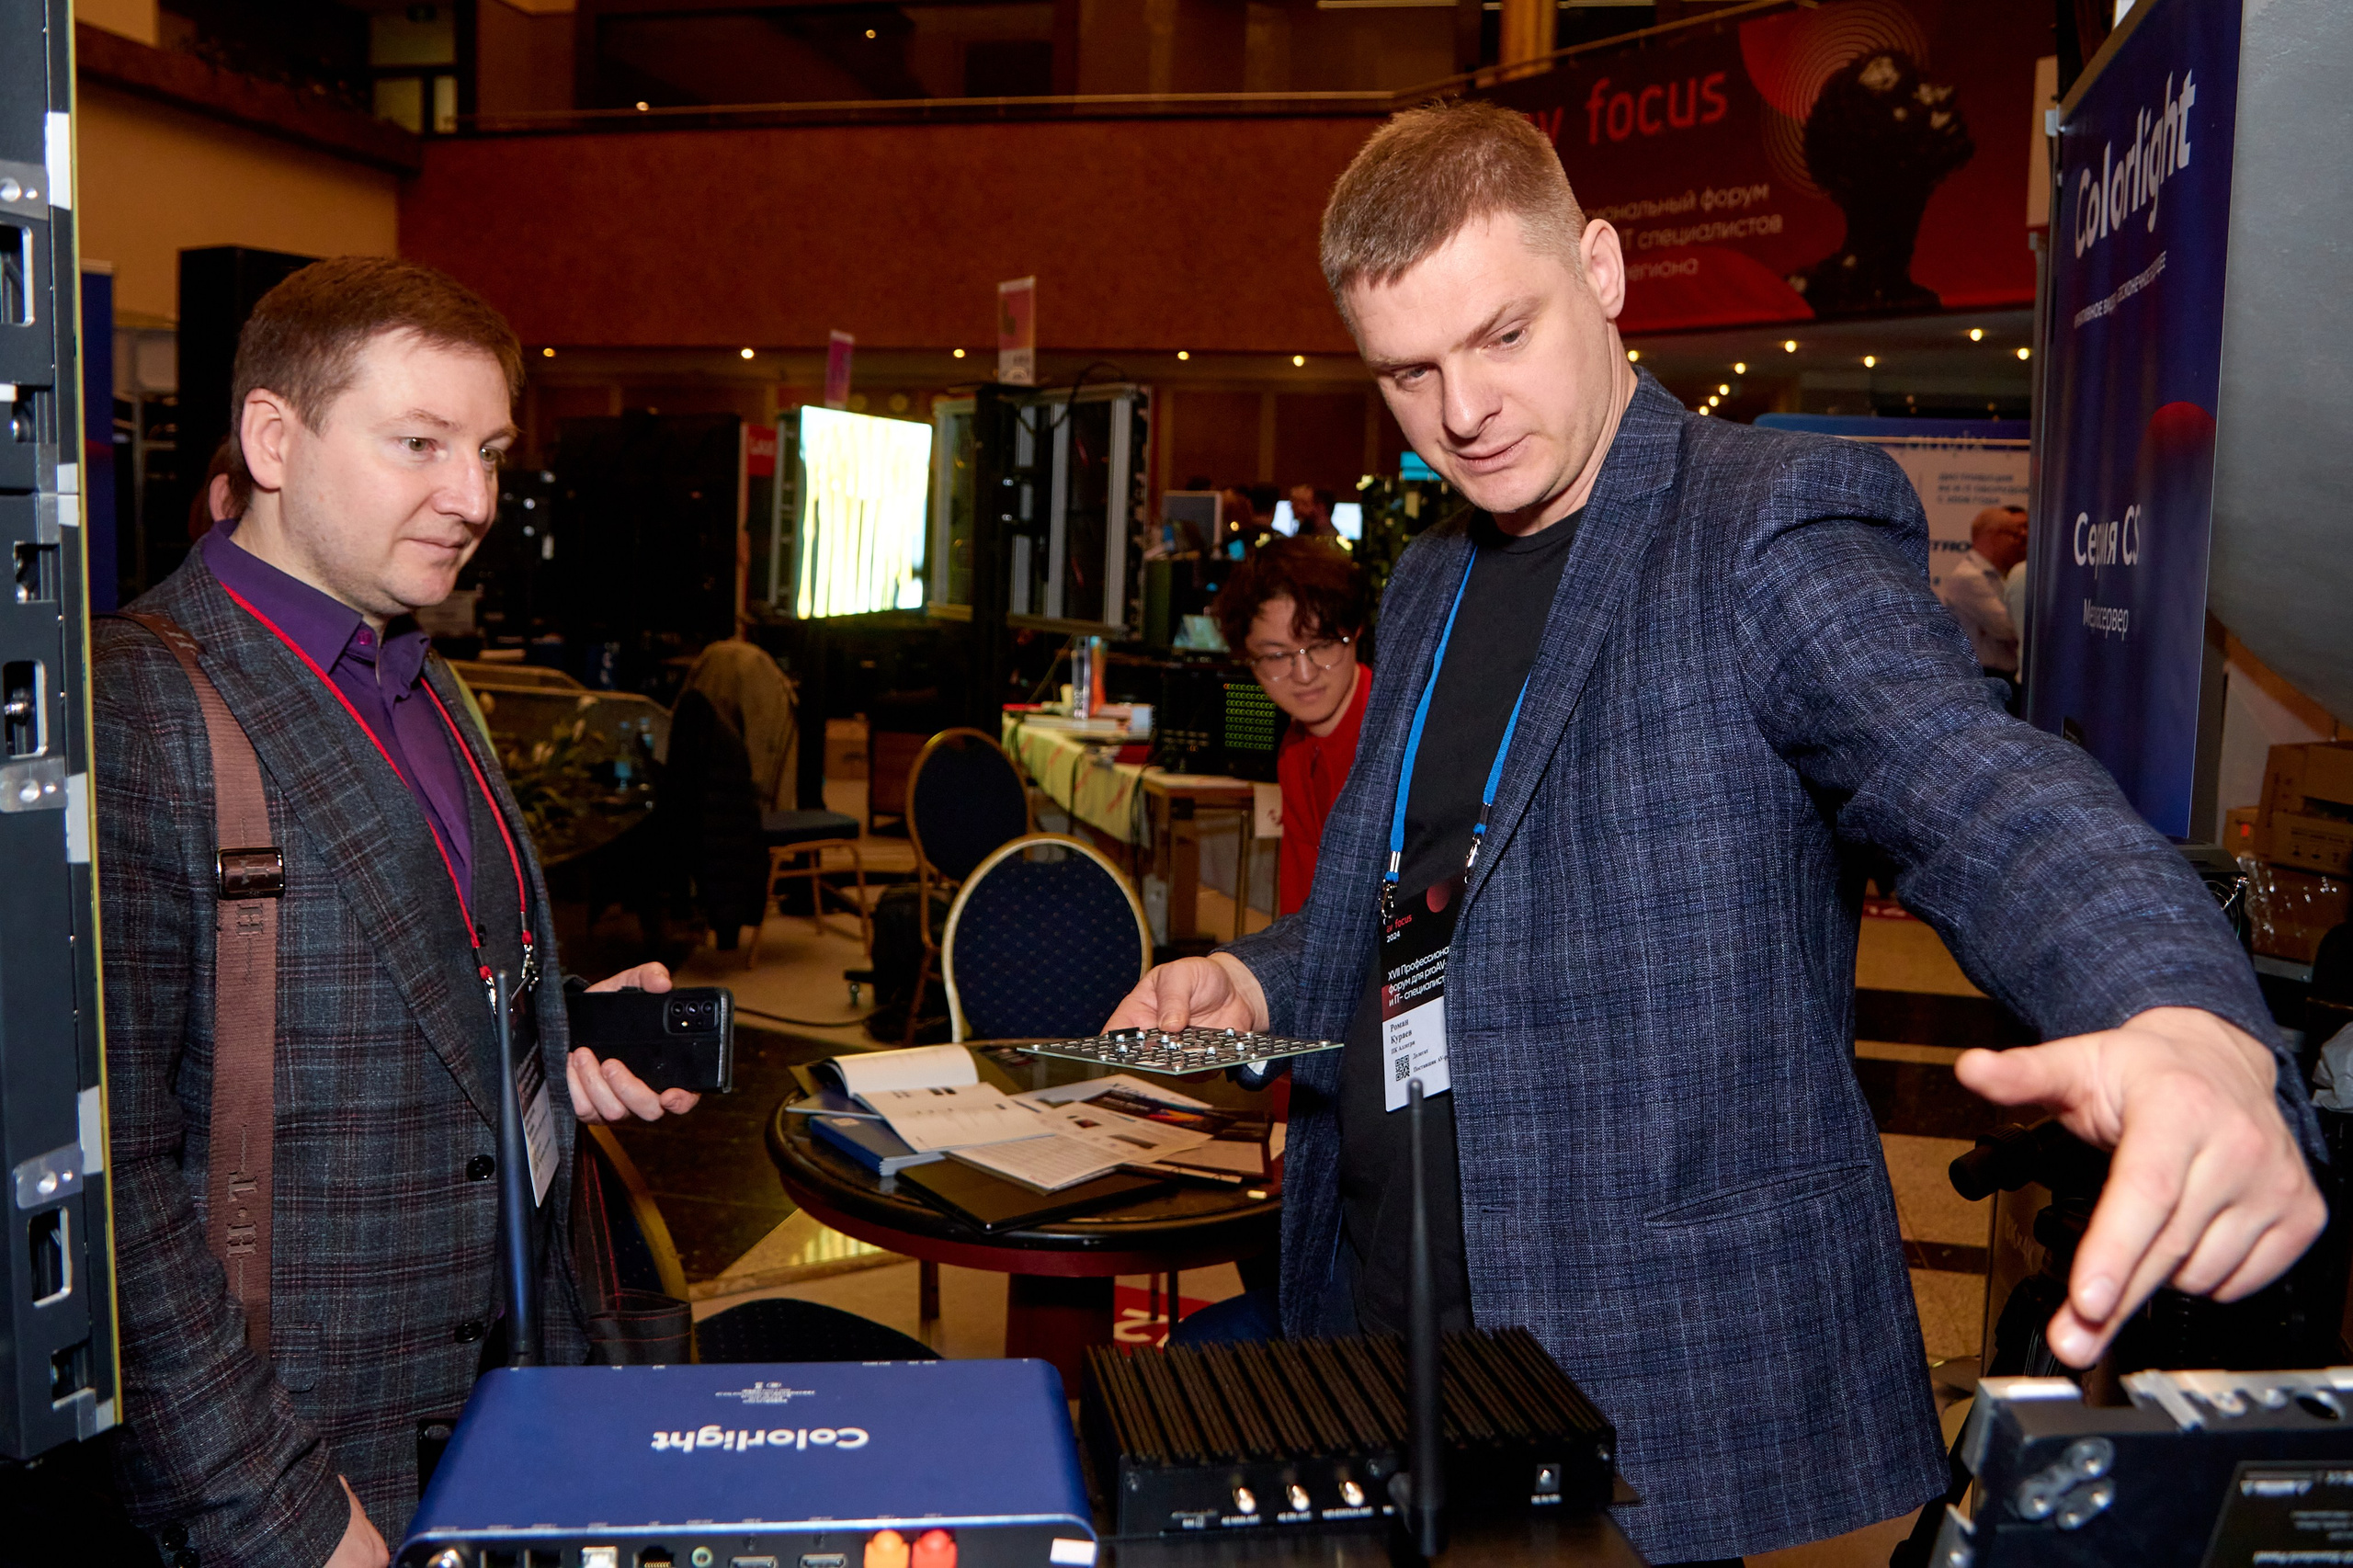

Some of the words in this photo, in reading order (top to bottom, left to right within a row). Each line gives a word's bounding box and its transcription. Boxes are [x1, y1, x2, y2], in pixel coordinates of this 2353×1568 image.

[1585, 71, 1728, 145] focus
[2075, 68, 2196, 259] Colorlight
[1699, 182, 1770, 213] форум
[1637, 214, 1783, 250] специалистов
[1625, 257, 1699, 281] егиона
[1394, 914, 1413, 928] focus
[1386, 930, 1401, 943] 2024
[1388, 977, 1411, 994] форум
[1411, 971, 1425, 985] для
[1388, 998, 1394, 1007] и
[1390, 1018, 1409, 1032] Роман
[1391, 1029, 1413, 1044] Кураев
[651, 1425, 870, 1453] Colorlight
